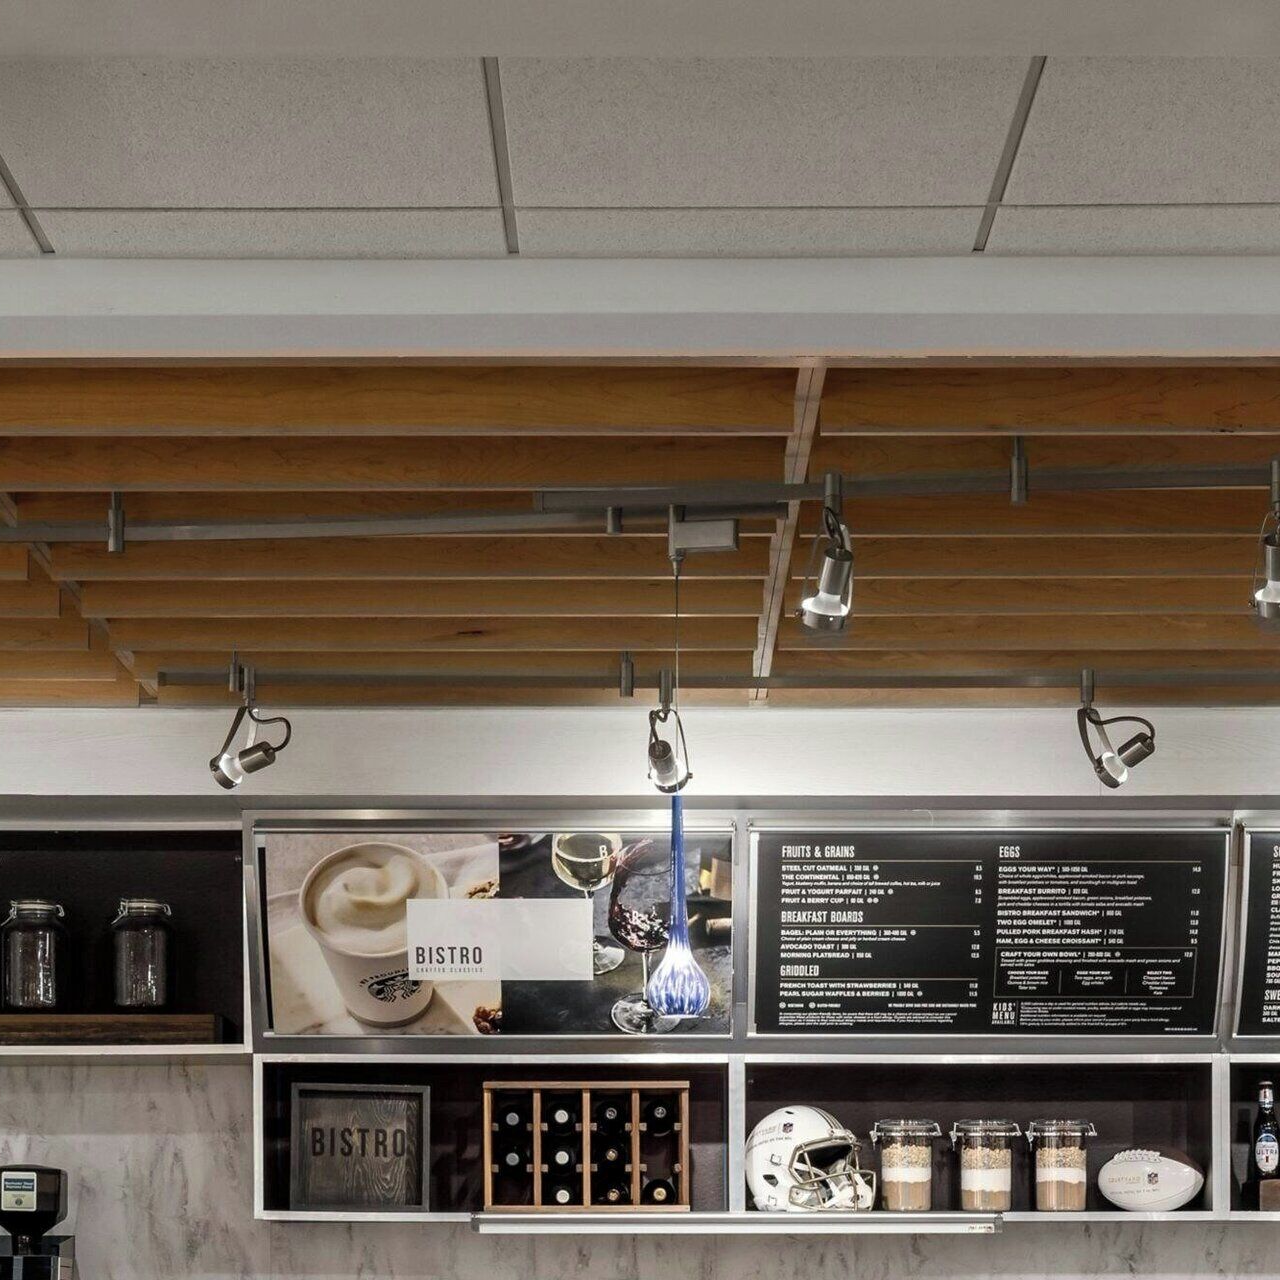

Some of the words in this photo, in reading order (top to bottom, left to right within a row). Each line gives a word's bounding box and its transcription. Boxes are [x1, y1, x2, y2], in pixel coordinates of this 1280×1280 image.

[782, 845, 811, 858] FRUITS
[814, 845, 822, 858] &
[824, 845, 855, 858] GRAINS
[999, 846, 1020, 858] EGGS
[781, 911, 827, 923] BREAKFAST
[830, 911, 864, 923] BOARDS
[415, 946, 483, 965] BISTRO
[780, 965, 820, 977] GRIDDLED
[993, 1003, 1016, 1012] KIDS'
[992, 1011, 1015, 1020] MENU
[311, 1127, 406, 1157] BISTRO
